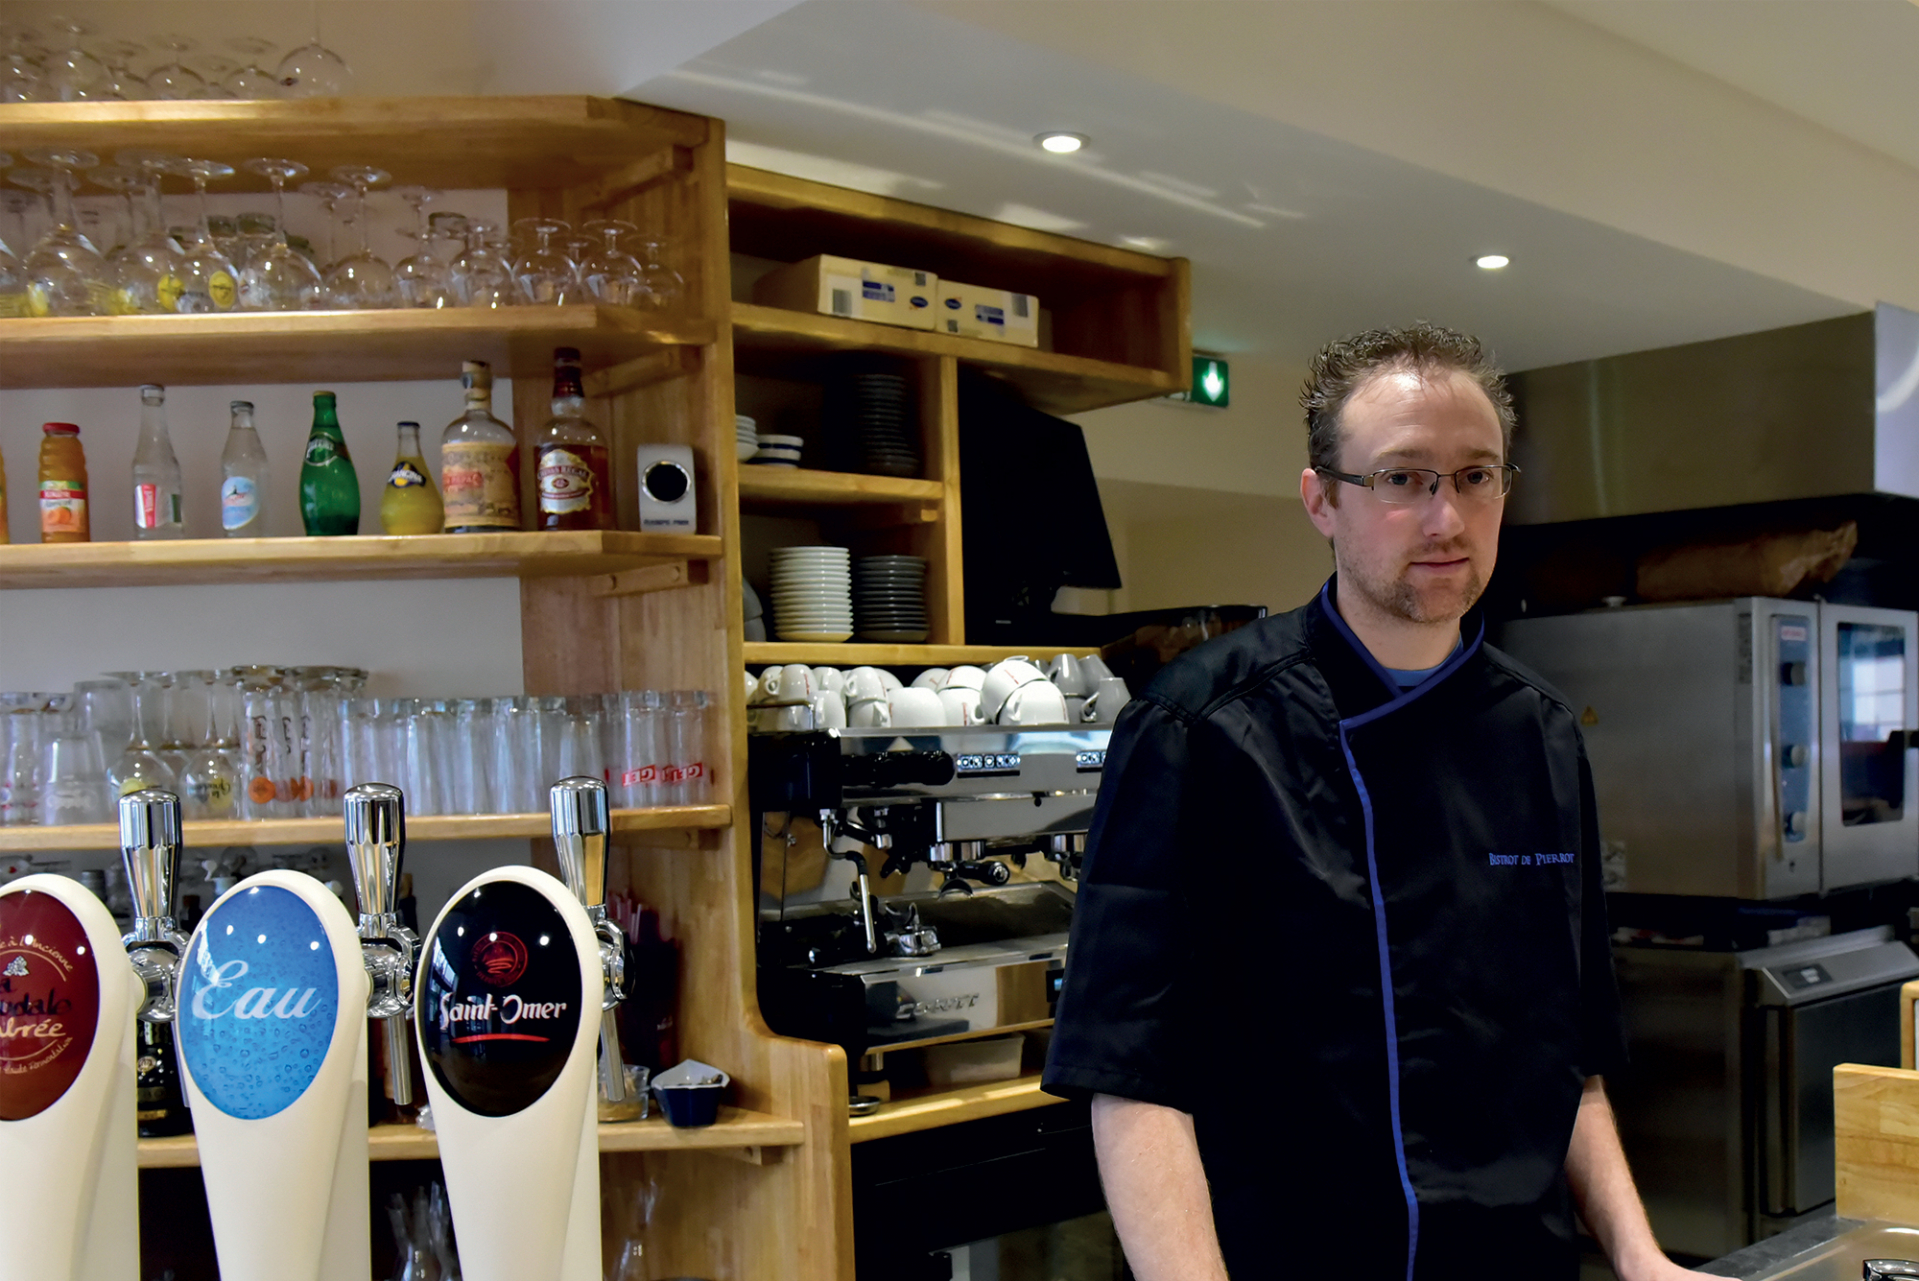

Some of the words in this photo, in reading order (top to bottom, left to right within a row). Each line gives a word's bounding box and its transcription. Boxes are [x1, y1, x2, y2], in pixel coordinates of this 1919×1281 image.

[622, 765, 656, 787] GET
[19, 935, 74, 972] lAncienne
[192, 960, 322, 1019] Eau
[440, 992, 567, 1030] Saint-Omer
